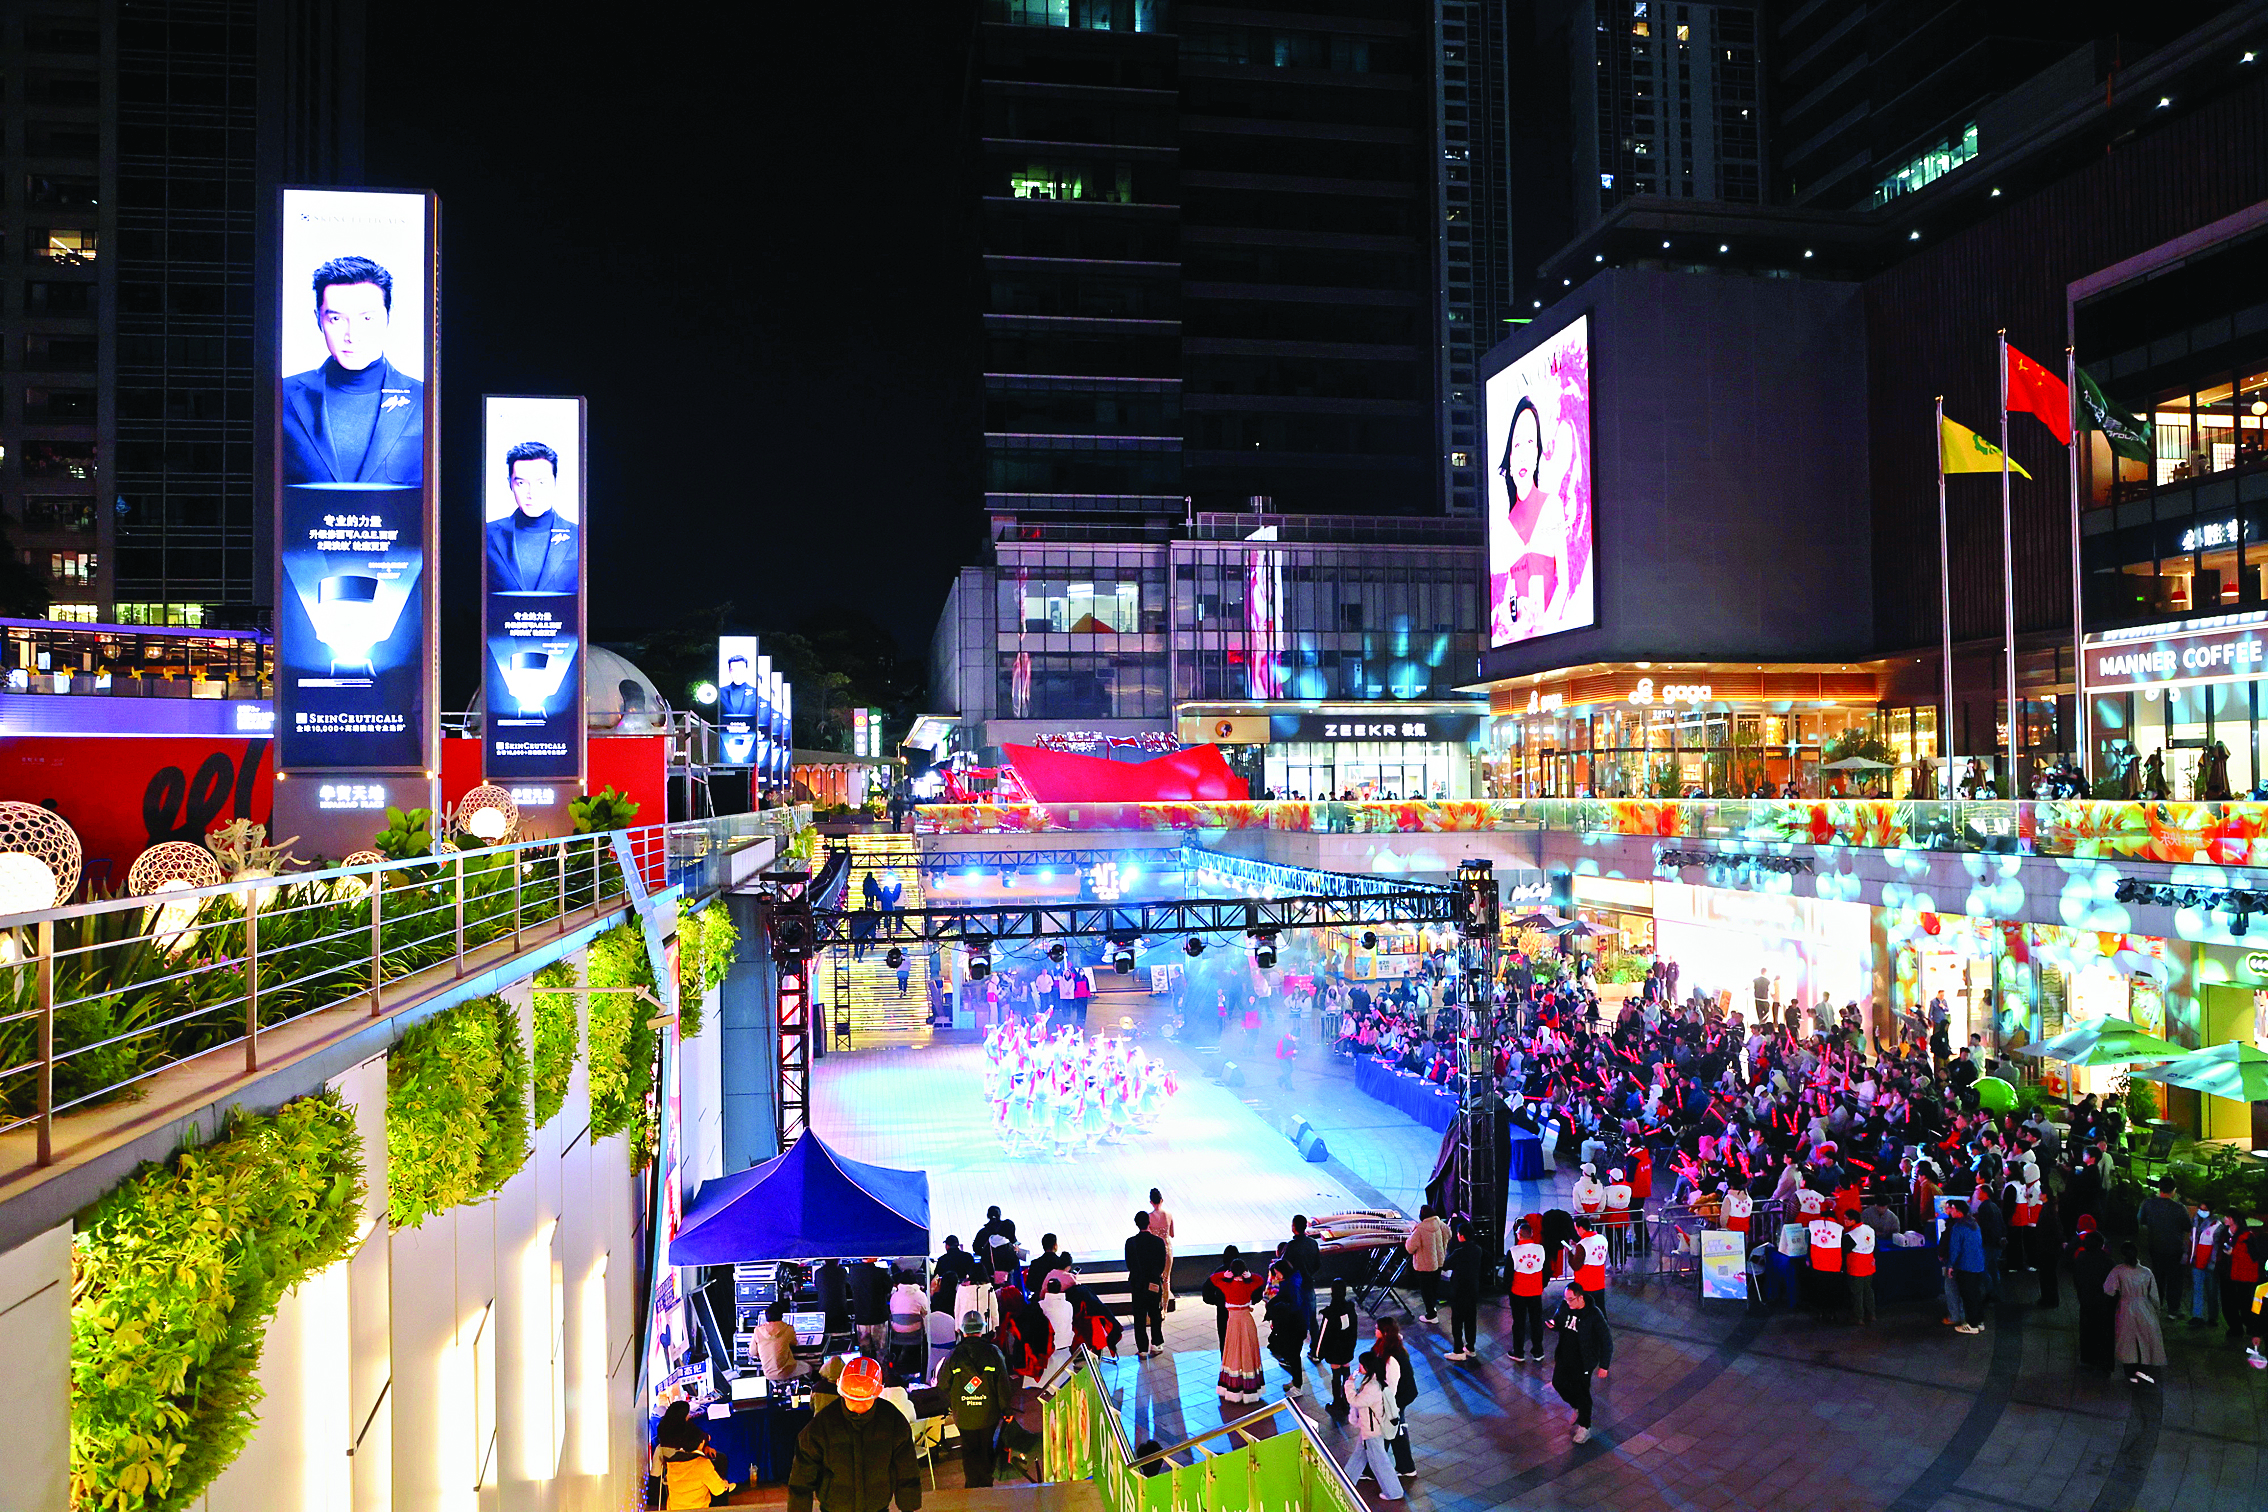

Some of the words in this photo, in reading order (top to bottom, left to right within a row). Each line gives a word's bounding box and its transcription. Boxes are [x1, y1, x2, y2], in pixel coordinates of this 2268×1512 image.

[2099, 650, 2178, 677] MANNER
[2182, 639, 2263, 669] COFFEE
[1662, 685, 1712, 705] gaga
[1324, 724, 1397, 737] ZEEKR
[960, 1394, 987, 1402] Domino's
